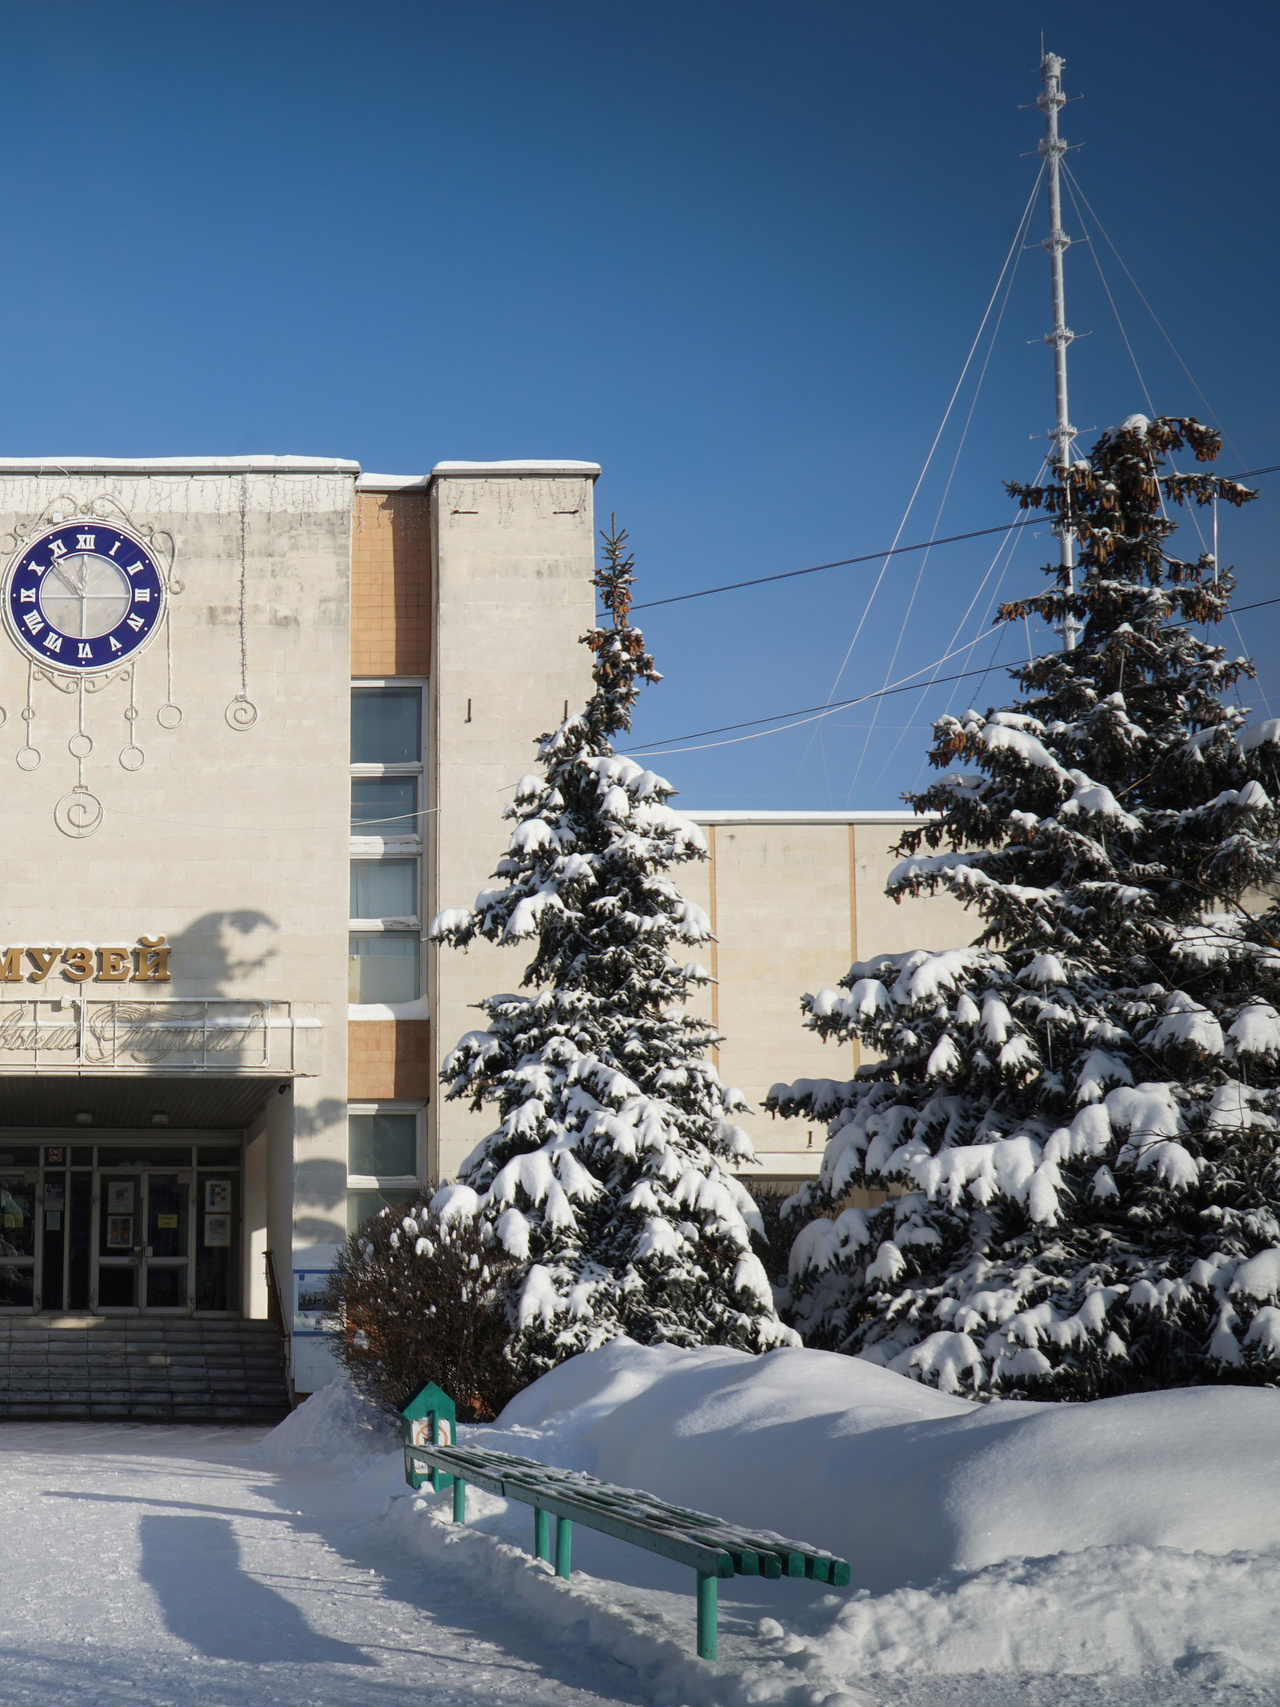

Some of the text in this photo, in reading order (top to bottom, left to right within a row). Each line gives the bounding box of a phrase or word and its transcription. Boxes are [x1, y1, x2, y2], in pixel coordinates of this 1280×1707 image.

[47, 539, 68, 557] XI
[75, 534, 96, 550] XII
[108, 541, 121, 556] I
[27, 560, 46, 577] X
[126, 561, 144, 576] II
[20, 588, 36, 603] IX
[135, 588, 151, 603] III
[22, 609, 45, 636] VIII
[126, 612, 145, 632] IV
[43, 632, 63, 653] VII
[109, 636, 123, 651] V
[77, 643, 93, 658] VI
